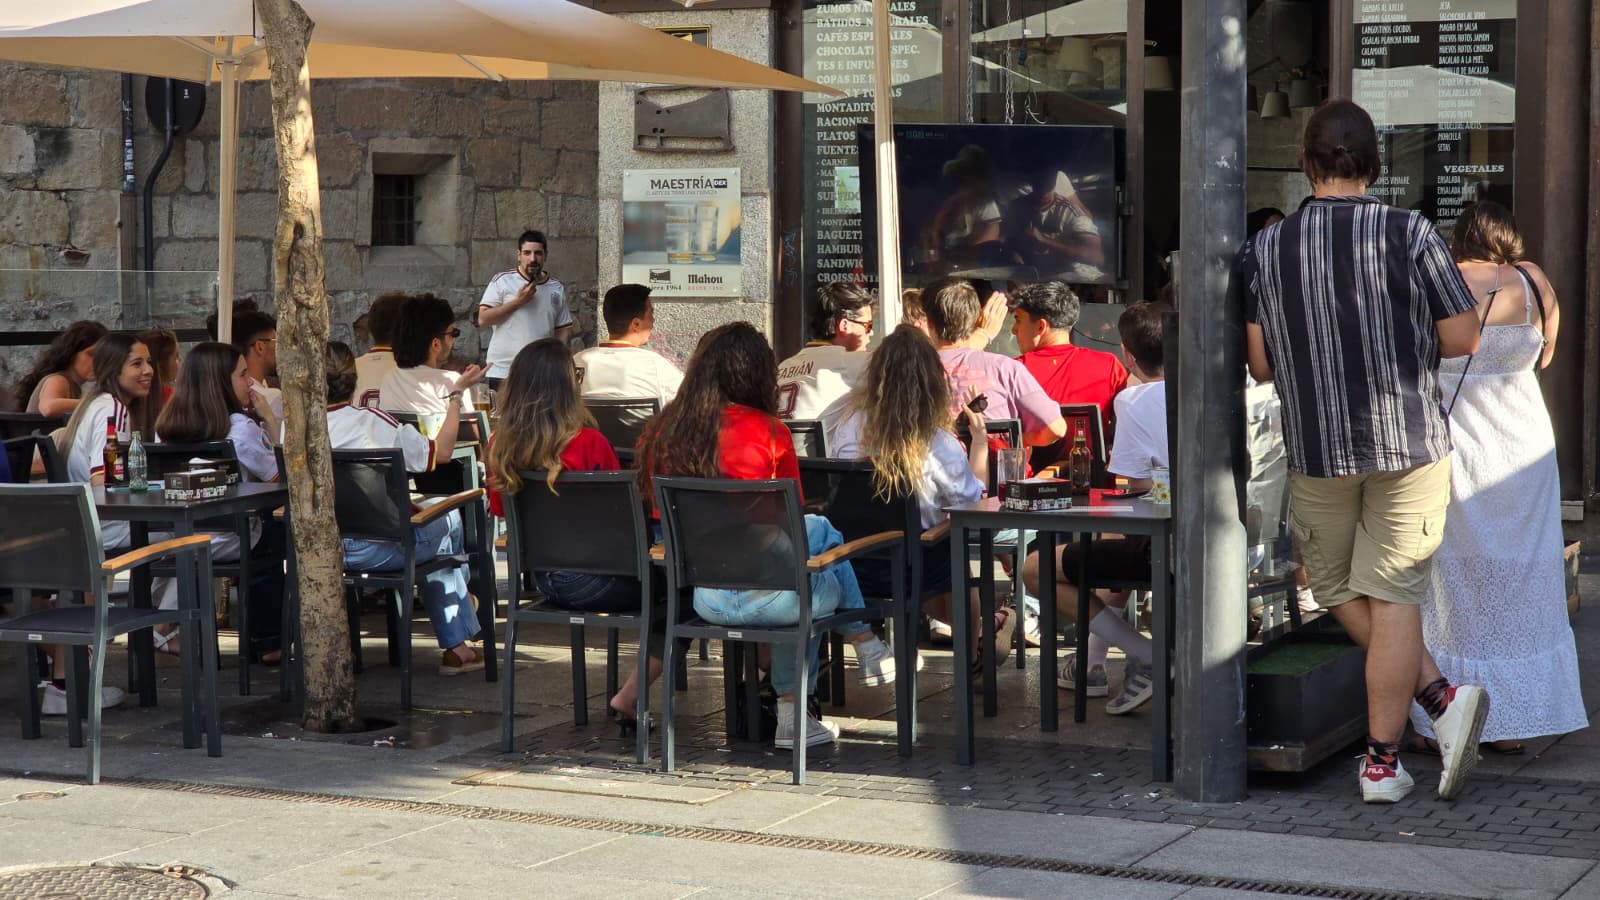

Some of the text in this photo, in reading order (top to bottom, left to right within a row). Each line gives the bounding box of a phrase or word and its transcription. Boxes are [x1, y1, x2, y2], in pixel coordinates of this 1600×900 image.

[816, 1, 916, 14] ZUMOS NATALES
[816, 15, 929, 28] BATIDOS NURALES
[1361, 24, 1411, 34] LANGOSTINOS COCIDOS
[1439, 22, 1478, 32] MAGRO EN SALSA
[816, 28, 849, 42] CAFÉS
[1361, 35, 1420, 45] CIGALAS PLANCHA UNIDAD
[1439, 34, 1457, 43] HUEVOS
[1458, 33, 1472, 42] ROTOS
[816, 44, 920, 56] CHOCOLAT SPEC.
[1361, 47, 1388, 56] CALAMARES
[1439, 44, 1494, 54] HUEVOS ROTOS CHORIZO
[816, 60, 836, 70] TES
[1439, 55, 1460, 65] BACALAO
[1473, 55, 1484, 64] MIEL
[816, 74, 849, 84] COPAS
[852, 74, 866, 83] DE
[816, 102, 876, 113] MONTADITO
[816, 115, 868, 127] RACIONES
[816, 131, 856, 141] PLATOS
[1438, 131, 1462, 141] MORCILLA
[816, 145, 859, 155] FUENTE
[1438, 143, 1451, 152] SETAS
[821, 158, 848, 167] CARNE
[1444, 164, 1505, 173] VEGETALES
[650, 175, 713, 190] MAESTRÍA
[1437, 175, 1461, 184] ENSALADA
[1437, 186, 1461, 195] ENSALADA
[1437, 208, 1464, 217] SETAS PLAN
[821, 218, 862, 227] MONTADIT
[816, 230, 862, 240] BAGUETT
[816, 244, 863, 254] HAMBUR
[687, 274, 723, 284] Mahou
[816, 272, 879, 283] CROISSANT
[1367, 767, 1385, 775] FILA
